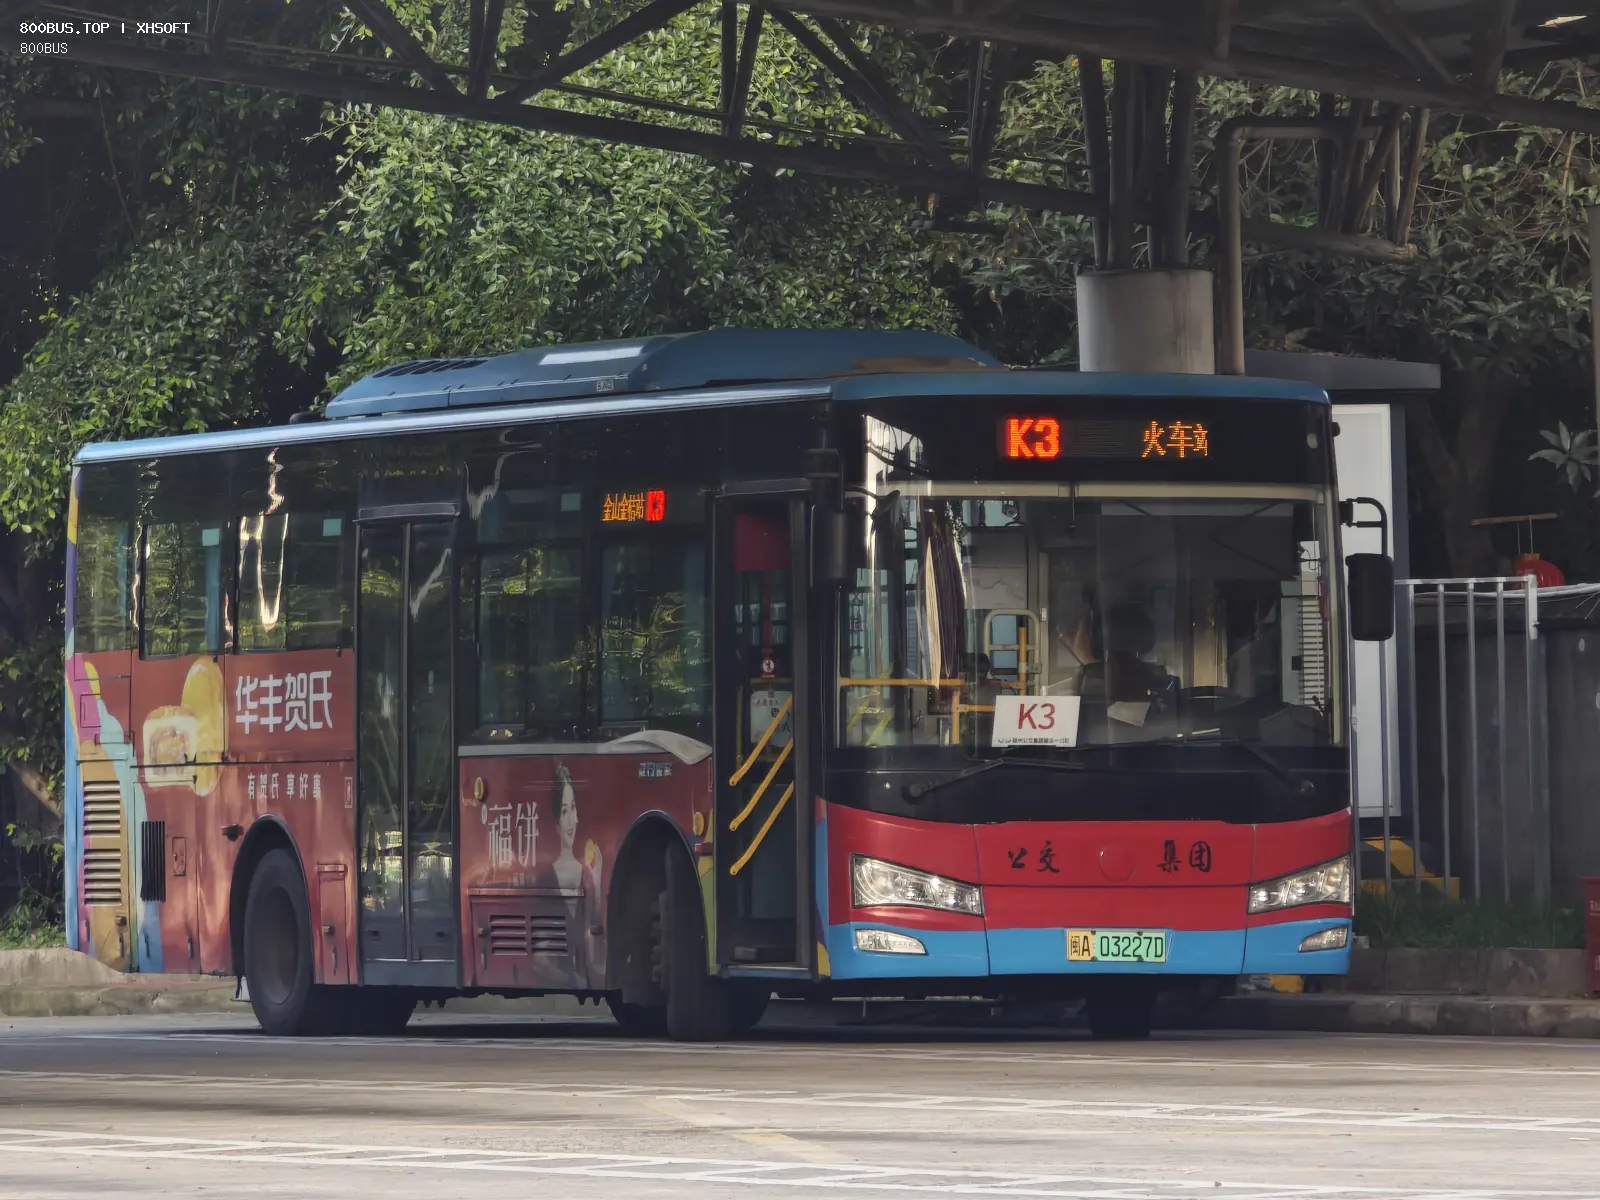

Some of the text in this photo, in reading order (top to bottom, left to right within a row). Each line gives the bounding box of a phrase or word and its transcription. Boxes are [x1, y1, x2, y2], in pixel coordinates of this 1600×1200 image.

[1009, 418, 1060, 458] K3
[236, 670, 333, 735] 华丰贺氏
[1018, 703, 1056, 730] K3
[247, 772, 279, 799] 有贺氏
[488, 801, 539, 868] 福饼
[1008, 839, 1212, 874] 公交 集团
